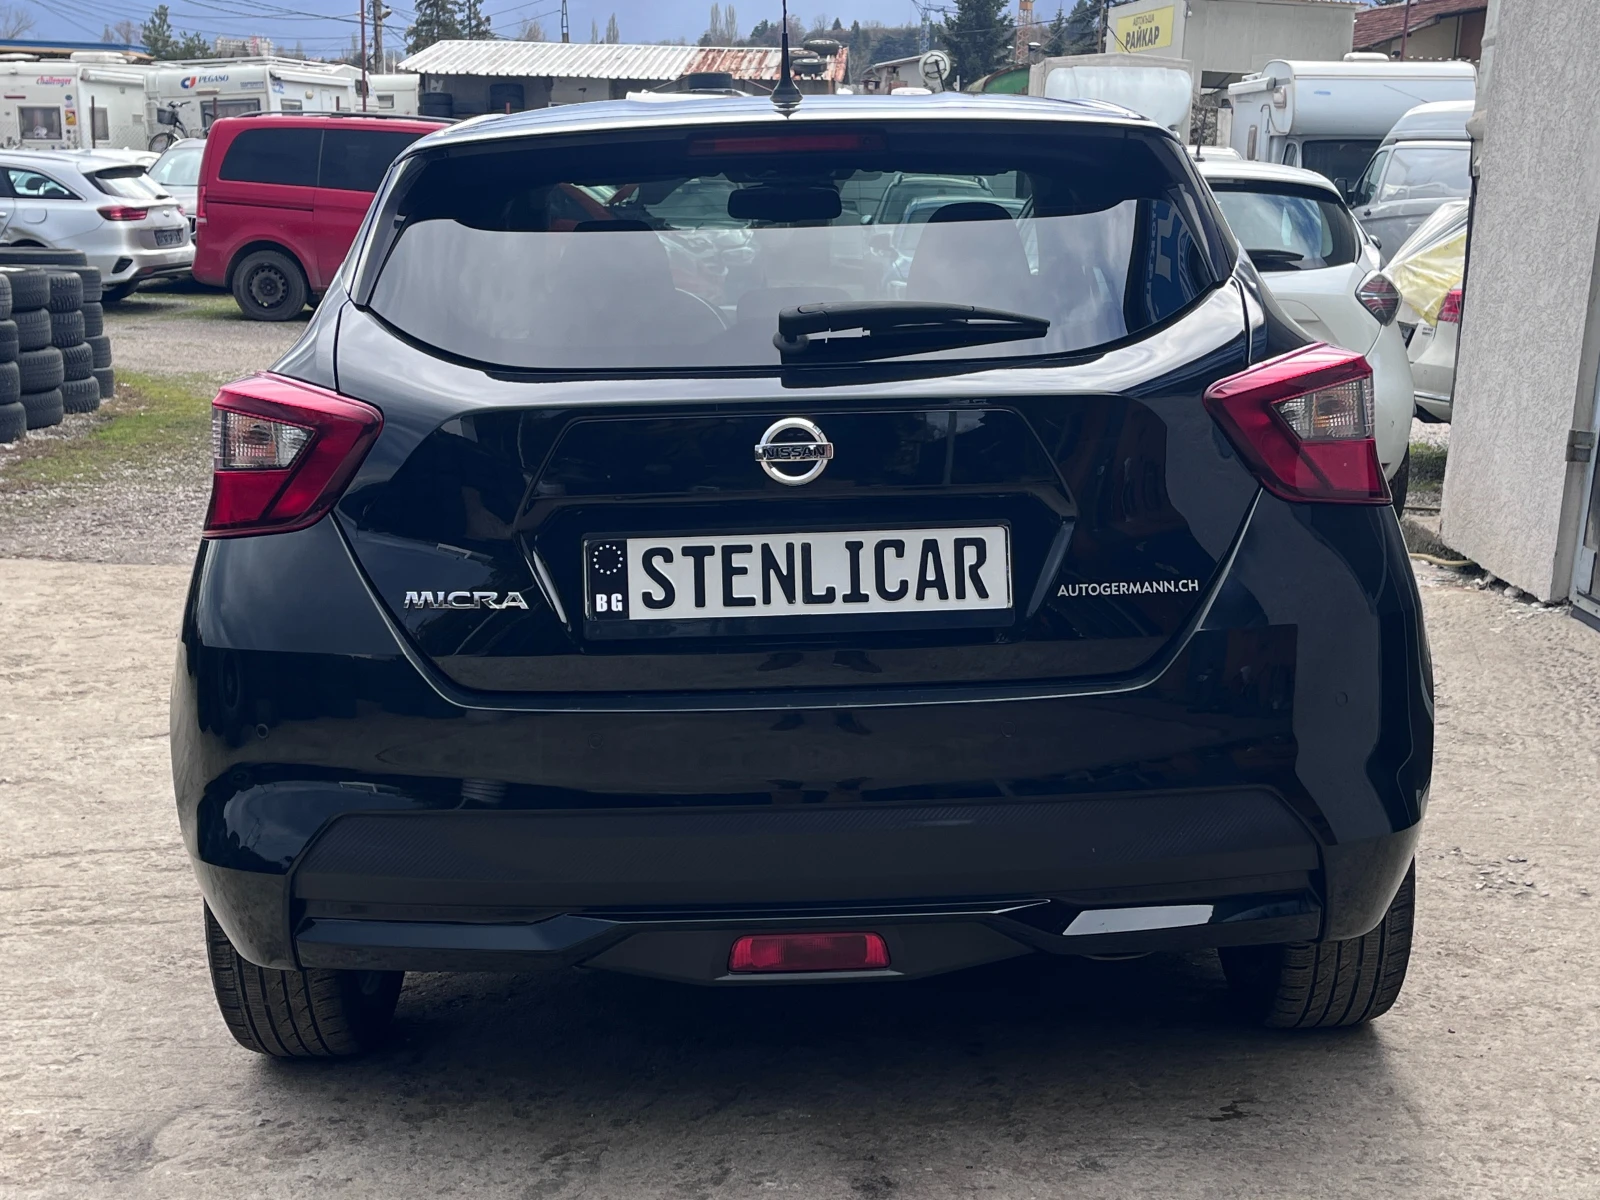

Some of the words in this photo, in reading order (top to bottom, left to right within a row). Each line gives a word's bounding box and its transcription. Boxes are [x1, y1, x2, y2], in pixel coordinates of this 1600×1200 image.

[1125, 25, 1160, 50] РАЙКАР
[198, 74, 229, 84] PEGASO
[763, 445, 826, 458] NISSAN
[641, 537, 990, 609] STENLICAR
[1057, 579, 1199, 597] AUTOGERMANN.CH
[403, 591, 530, 610] MICRA
[596, 593, 623, 612] BG
